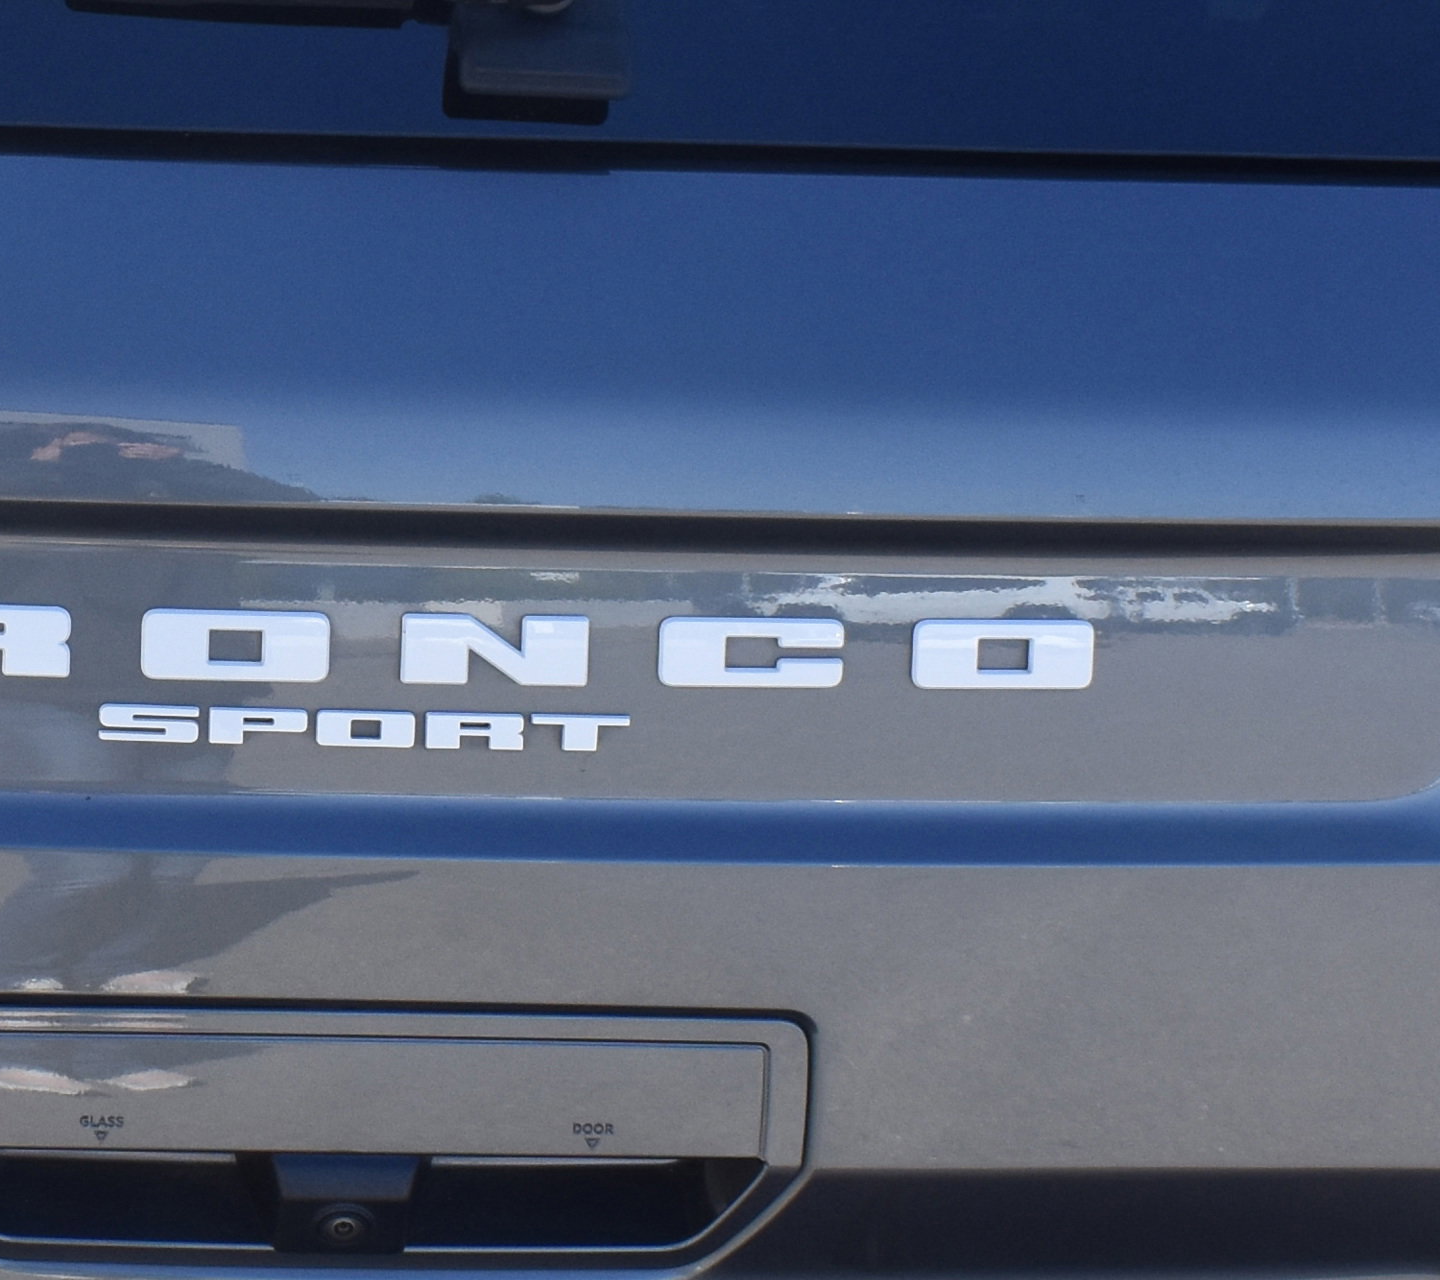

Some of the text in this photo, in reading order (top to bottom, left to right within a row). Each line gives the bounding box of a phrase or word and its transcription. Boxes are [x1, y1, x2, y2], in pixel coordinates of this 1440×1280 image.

[97, 704, 631, 754] SPORT
[79, 1114, 125, 1128] GLASS
[572, 1122, 614, 1135] DOOR
